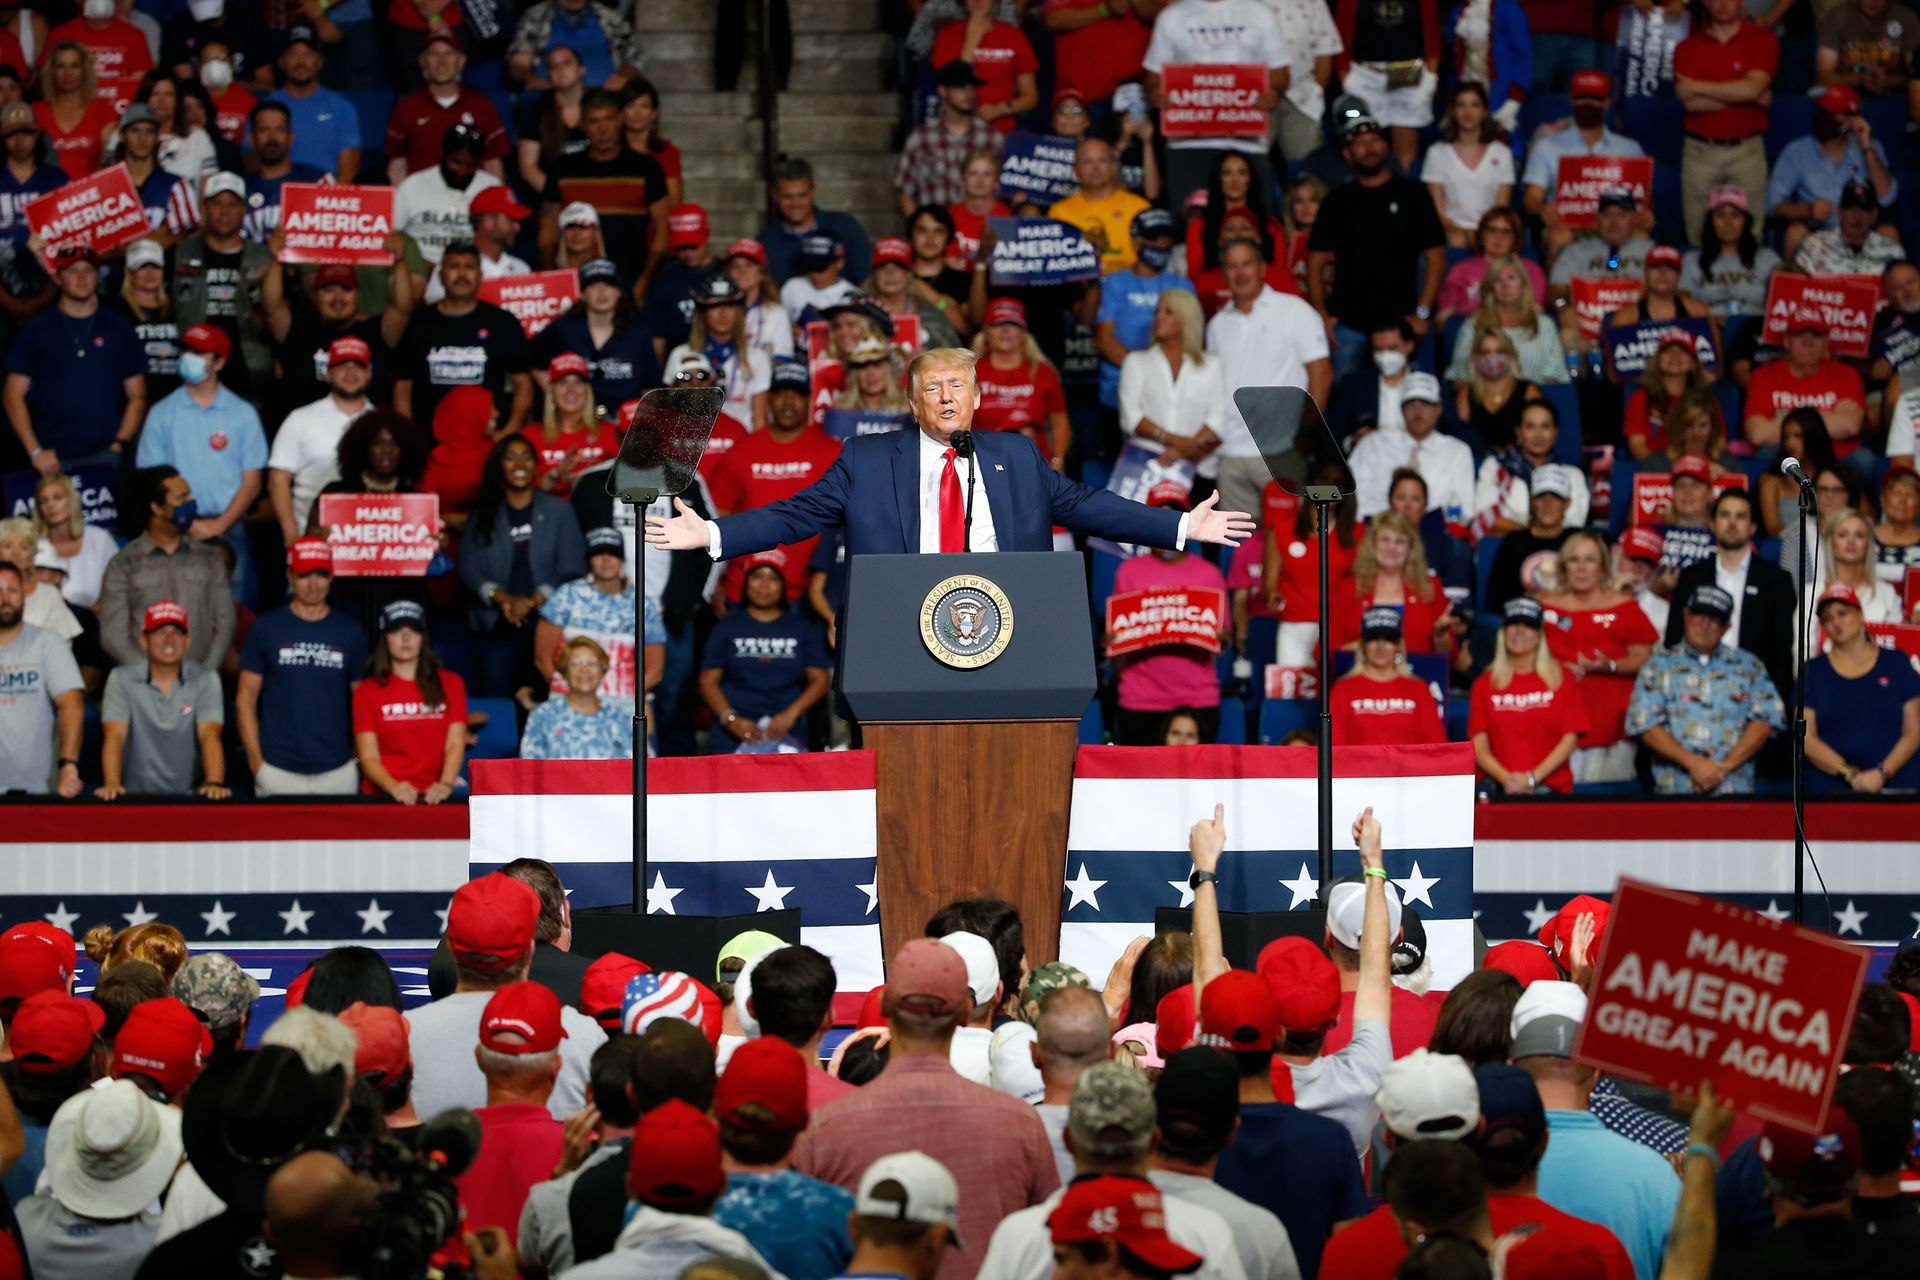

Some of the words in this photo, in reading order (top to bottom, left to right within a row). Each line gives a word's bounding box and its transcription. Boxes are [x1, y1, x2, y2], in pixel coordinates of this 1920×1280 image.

[1193, 74, 1236, 87] MAKE
[1167, 108, 1214, 122] GREAT
[1216, 108, 1264, 122] AGAIN
[1582, 166, 1622, 180] MAKE
[1000, 173, 1050, 192] GREAT
[57, 186, 101, 214] MAKE
[315, 196, 361, 212] MAKE
[40, 192, 136, 240] AMERICA
[285, 211, 389, 234] AMERICA
[96, 211, 142, 238] AGAIN
[1018, 224, 1063, 239] MAKE
[285, 233, 336, 249] GREAT
[993, 237, 1094, 258] AMERICA
[993, 258, 1045, 273] GREAT
[1046, 254, 1096, 272] AGAIN
[501, 283, 544, 299] MAKE
[1802, 287, 1845, 305] MAKE
[1829, 328, 1866, 343] GAIN
[980, 381, 1035, 396] Trump
[1772, 391, 1837, 409] TRUMP
[543, 447, 604, 460] TRMP
[751, 461, 812, 476] TRUMP
[355, 507, 402, 521] MAKE
[327, 523, 433, 543] AMERICA
[1665, 530, 1711, 545] MAKE
[382, 545, 435, 561] AGAIN
[980, 582, 992, 592] THE
[924, 578, 968, 616] PRESIDENT
[1141, 594, 1189, 609] MAKE
[993, 592, 1011, 631] UNITED
[1112, 605, 1218, 631] AMERICA
[924, 620, 932, 632] THE
[1166, 620, 1219, 639] AGAIN
[734, 637, 799, 649] TRUMP
[926, 634, 934, 643] OF
[932, 644, 957, 663] SEAL
[973, 640, 1006, 664] STATES
[1351, 698, 1416, 710] TRUMP
[1491, 690, 1554, 706] TRUMP
[1686, 929, 1788, 985] MAKE
[1604, 952, 1831, 1056] AMERICA
[1595, 1001, 1718, 1060] GREAT
[1718, 1038, 1825, 1097] AGAIN
[1087, 1205, 1119, 1234] 45
